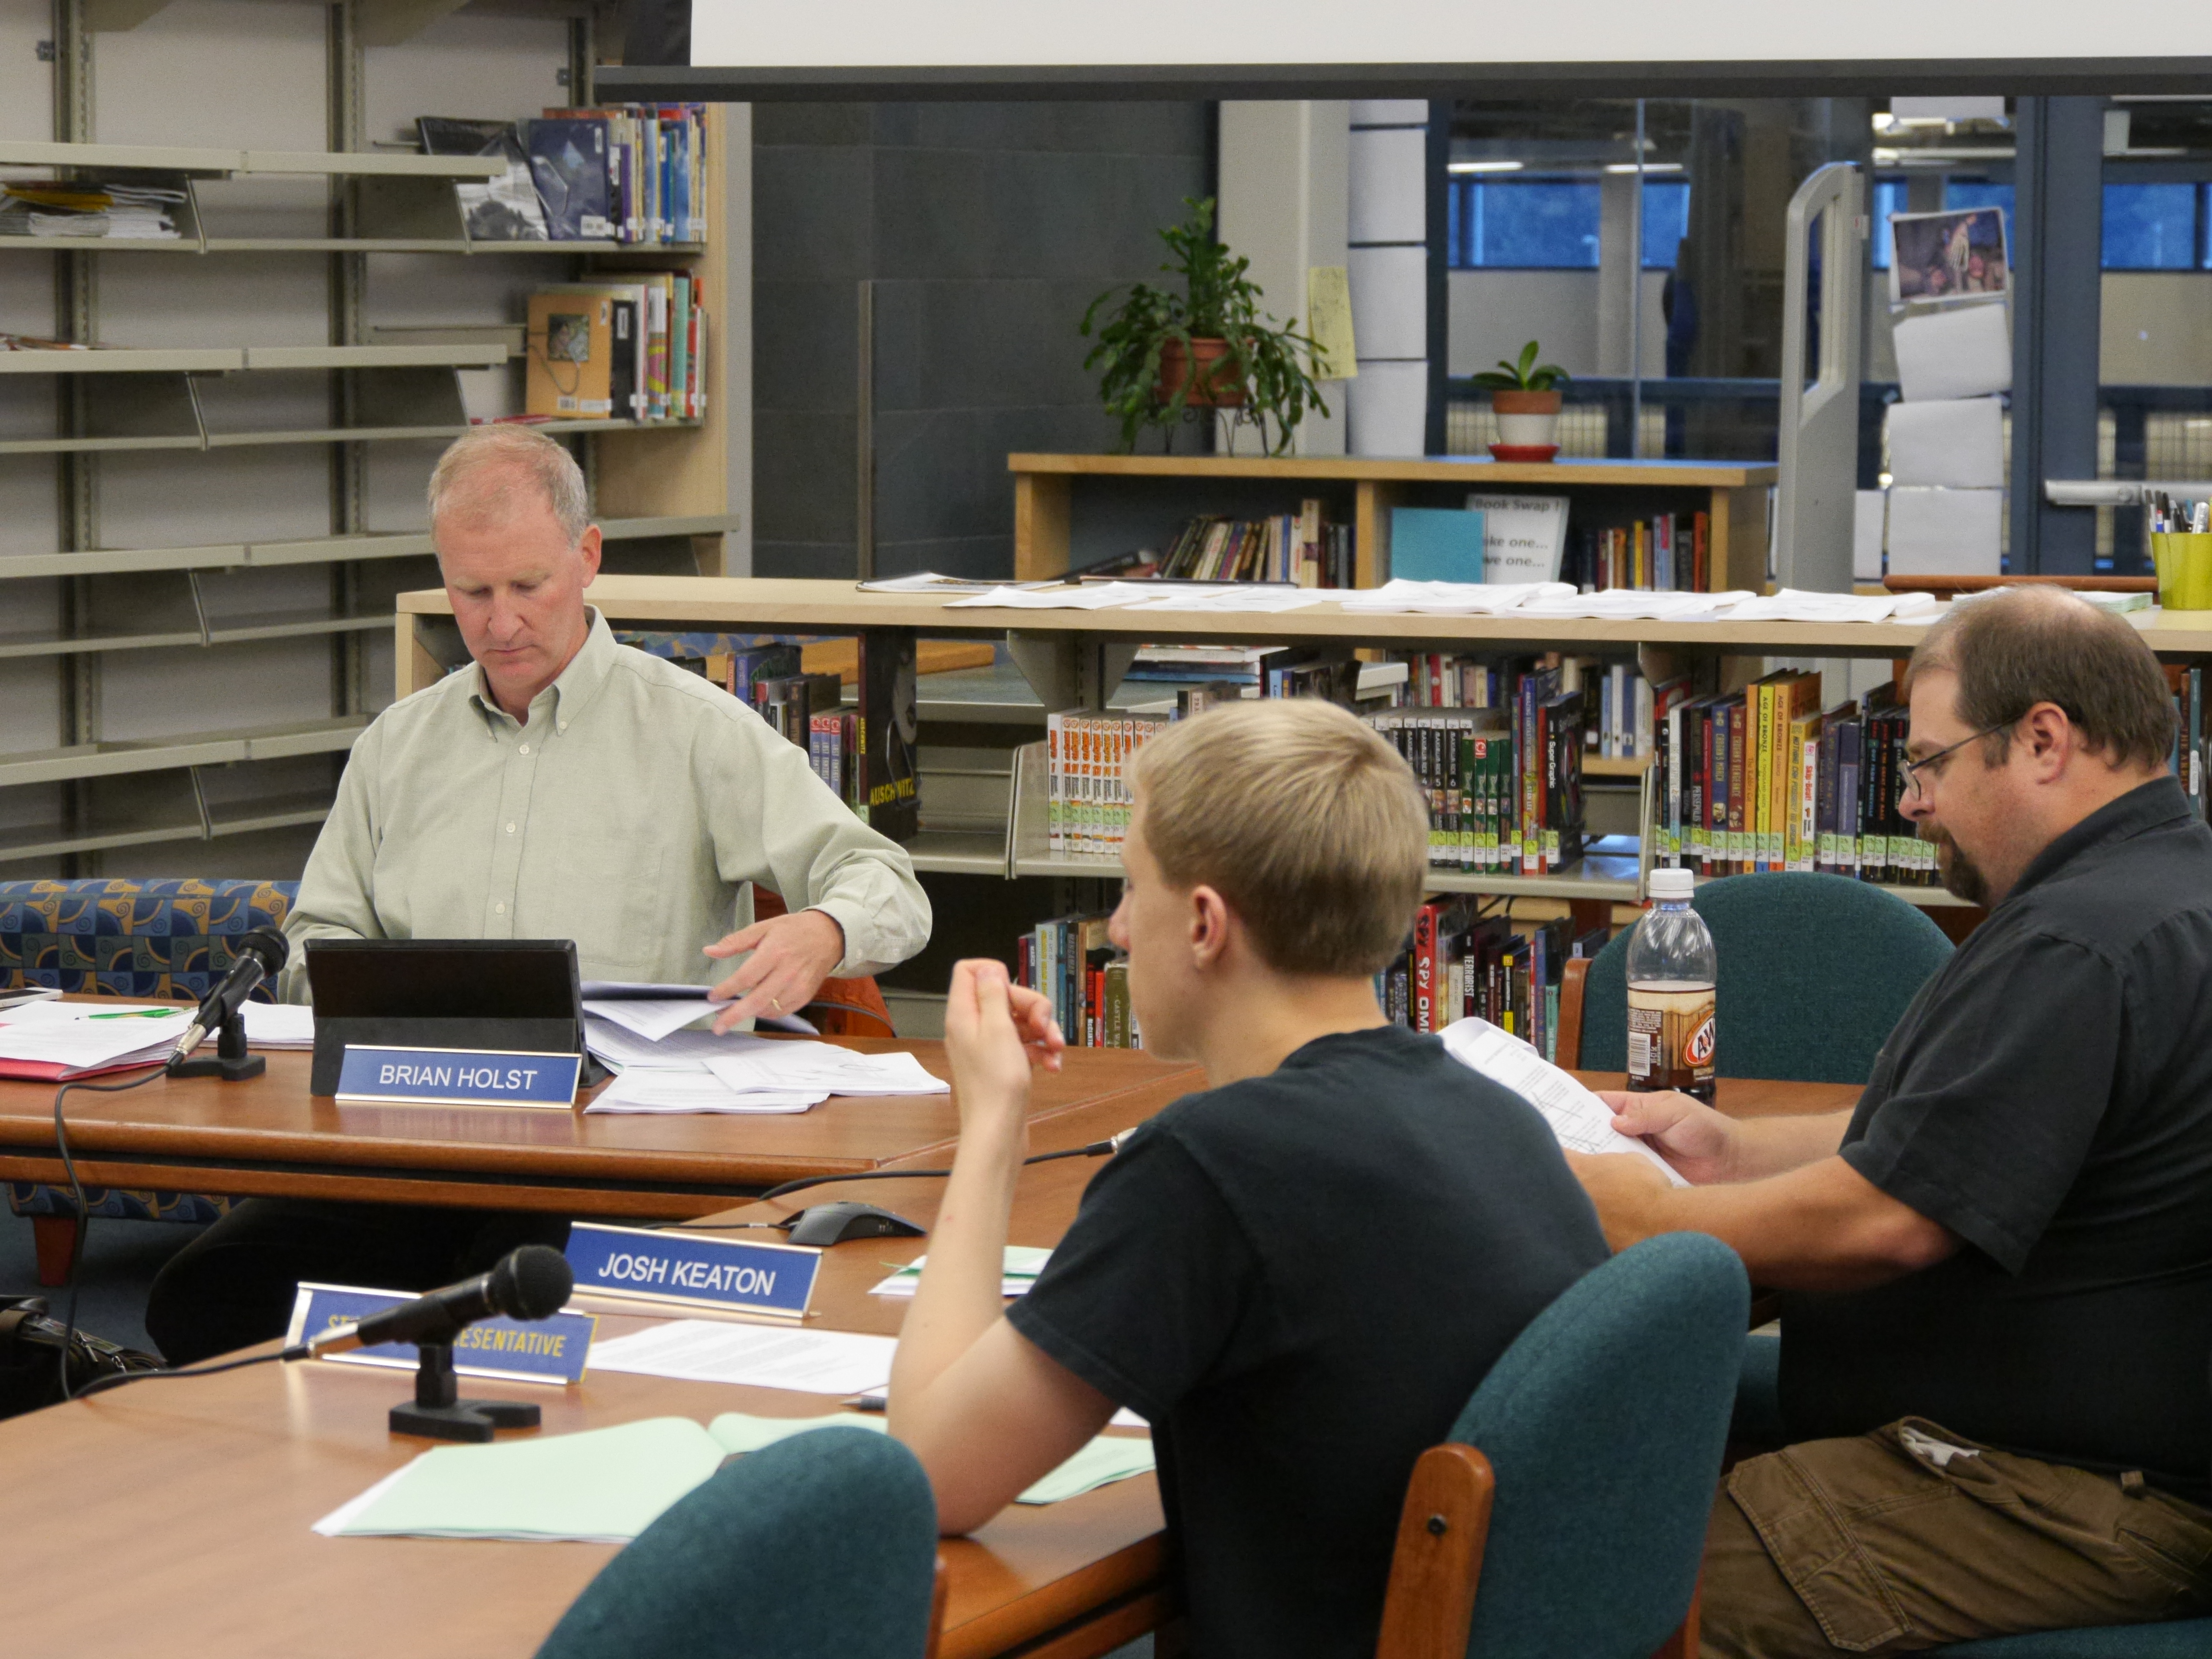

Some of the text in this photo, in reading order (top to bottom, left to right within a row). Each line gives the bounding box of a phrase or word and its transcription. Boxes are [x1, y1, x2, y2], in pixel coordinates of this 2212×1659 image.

[1513, 500, 1550, 512] Swap
[1763, 713, 1768, 721] OF
[1777, 712, 1783, 720] OF
[1435, 778, 1441, 786] 5
[1450, 779, 1456, 787] 6
[1716, 762, 1725, 782] MARCH
[869, 778, 915, 806] AUSCHWITZ
[1693, 786, 1702, 821] PERSEPOLIS
[1418, 914, 1430, 947] SPY
[1419, 956, 1430, 989] SPY
[1464, 955, 1474, 998] TERRORIST
[379, 1064, 538, 1090] BRIAN HOLST
[598, 1253, 776, 1296] JOSH KEATON
